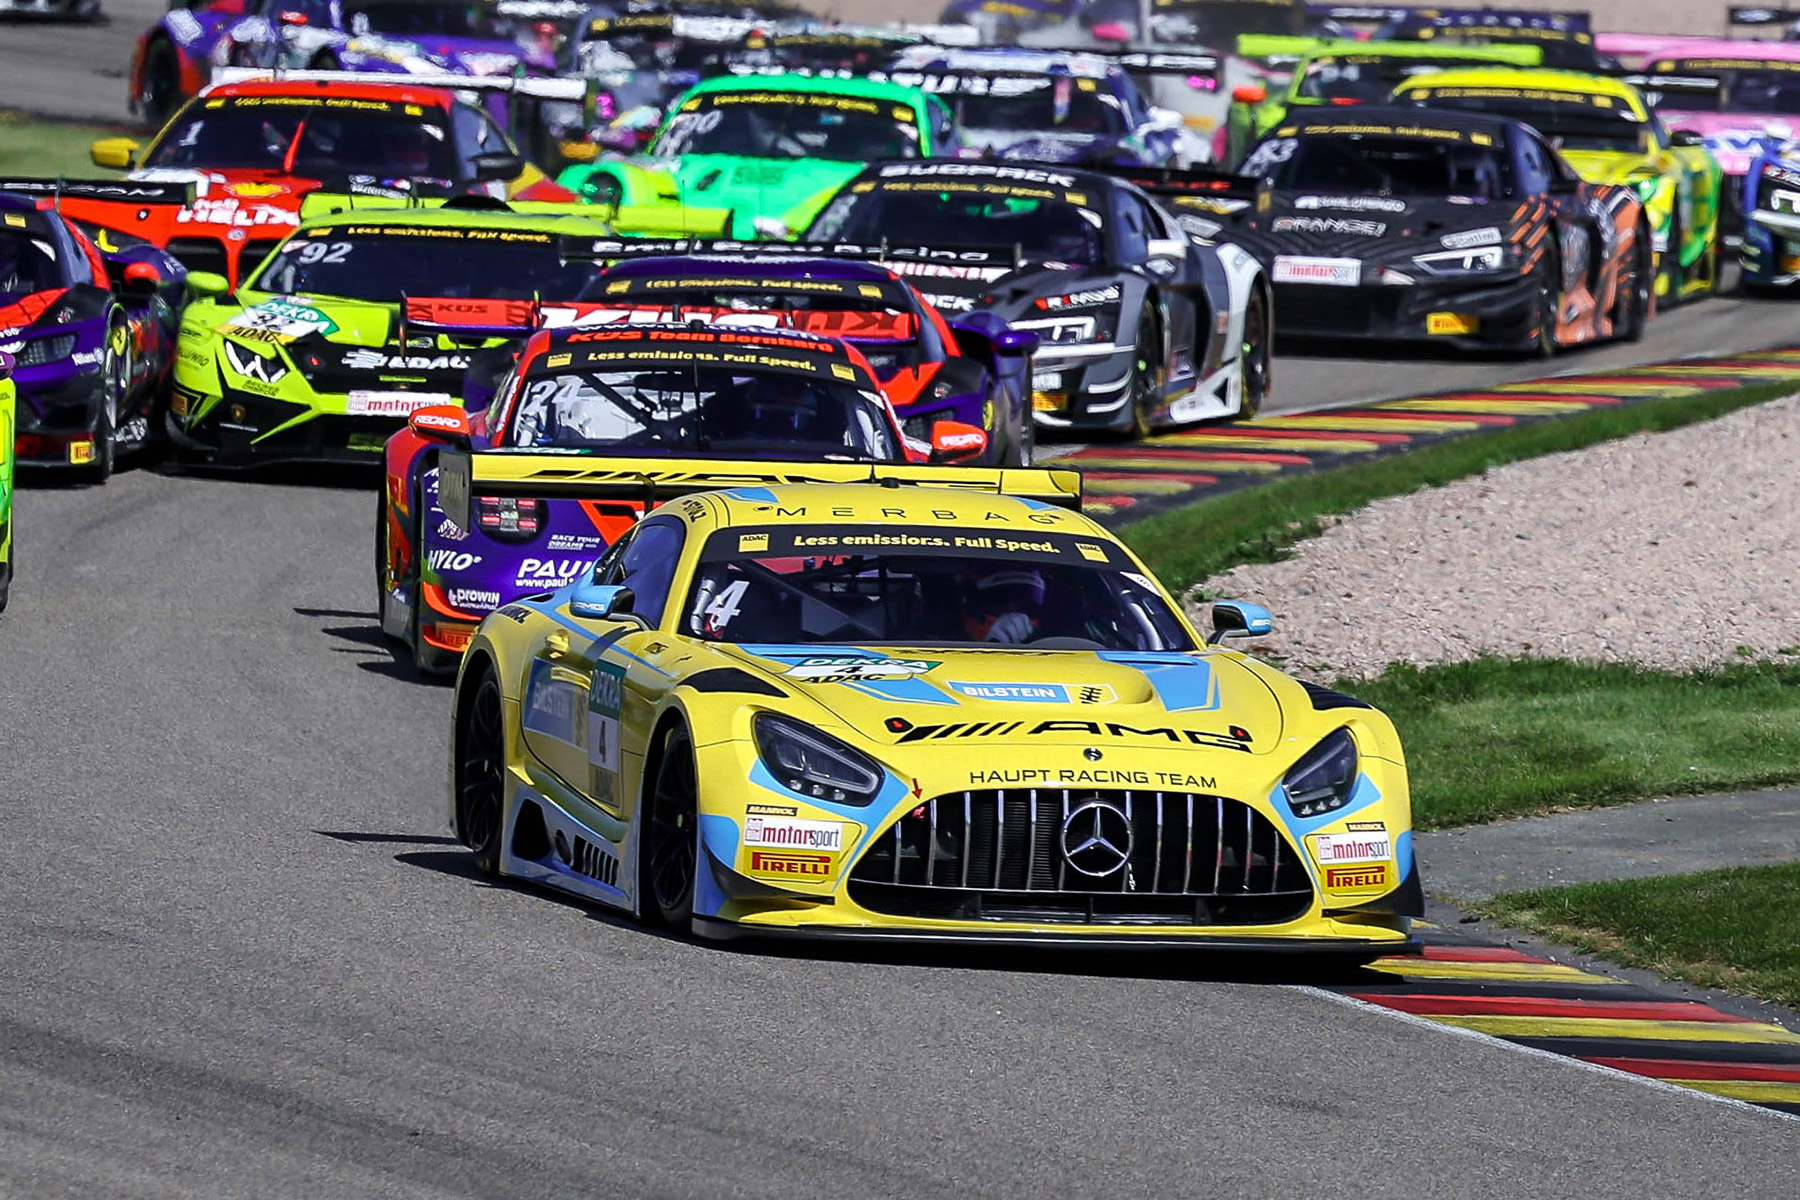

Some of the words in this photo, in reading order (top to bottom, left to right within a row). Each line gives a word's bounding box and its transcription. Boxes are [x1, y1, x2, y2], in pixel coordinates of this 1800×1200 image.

[299, 242, 354, 264] 92
[587, 352, 625, 361] Less
[723, 354, 758, 364] Full
[759, 356, 816, 371] Speed.
[523, 374, 584, 416] 24
[413, 415, 461, 428] RECARO
[776, 507, 1055, 525] MERBAG
[793, 535, 838, 547] Less
[842, 534, 951, 547] emissions.
[954, 537, 992, 548] Full
[996, 539, 1061, 554] Speed.
[708, 579, 750, 626] 4
[803, 658, 930, 670] DEKRA
[838, 666, 865, 674] 4
[800, 674, 887, 684] ADAC
[963, 685, 1057, 699] BILSTEIN
[1027, 720, 1254, 754] AMG
[970, 769, 1050, 784] HAUPT
[1059, 768, 1150, 784] RACING
[1155, 771, 1218, 788] TEAM
[762, 826, 840, 848] motorsport
[1333, 839, 1390, 860] motorsport
[751, 851, 832, 875] PIRELLI
[1326, 865, 1386, 888] PIRELLI
